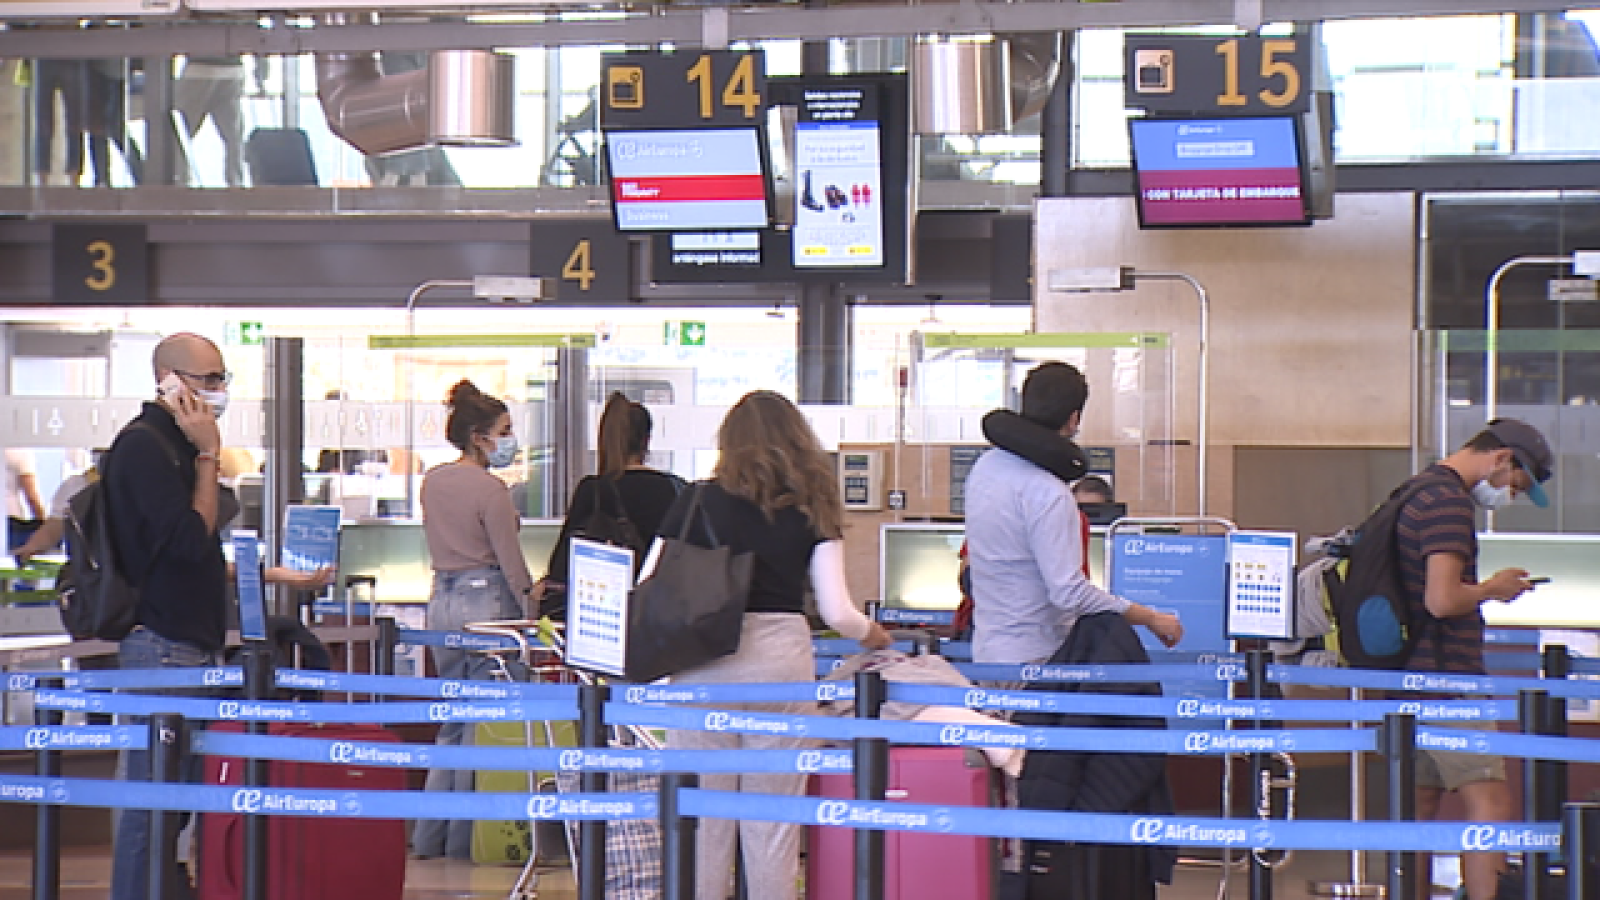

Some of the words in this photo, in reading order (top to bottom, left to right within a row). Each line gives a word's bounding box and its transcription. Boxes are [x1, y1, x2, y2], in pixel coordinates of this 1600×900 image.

[1215, 40, 1299, 107] 15
[686, 55, 761, 118] 14
[1147, 188, 1171, 200] CON
[1174, 188, 1221, 200] TARJETA
[1223, 188, 1236, 199] DE
[1239, 186, 1299, 199] EMBARQUE
[84, 241, 115, 291] 3
[562, 240, 595, 291] 4
[1145, 542, 1193, 556] AirEuropa
[279, 674, 326, 688] AirEuropa
[1042, 669, 1091, 680] AirEuropa
[461, 686, 508, 699] AirEuropa
[1424, 678, 1478, 691] AirEuropa
[35, 692, 86, 709] AirEuropa
[646, 689, 694, 703] AirEuropa
[987, 694, 1041, 709] AirEuropa
[240, 706, 293, 720] AirEuropa
[452, 706, 506, 718] AirEuropa
[1200, 703, 1255, 718] AirEuropa
[1423, 704, 1481, 719] AirEuropa
[731, 716, 789, 733] AirEuropa
[51, 731, 111, 747] AirEuropa
[966, 729, 1026, 746] AirEuropa
[1212, 736, 1275, 750] AirEuropa
[1416, 733, 1469, 750] rEuropa
[354, 745, 411, 764] AirEuropa
[584, 753, 643, 770] AirEuropa
[0, 784, 44, 799] uropa
[264, 794, 337, 814] AirEuropa
[559, 799, 633, 817] AirEuropa
[850, 806, 927, 828] AirEuropa
[1165, 823, 1246, 846] AirEuropa
[1499, 829, 1561, 847] AirEuro
